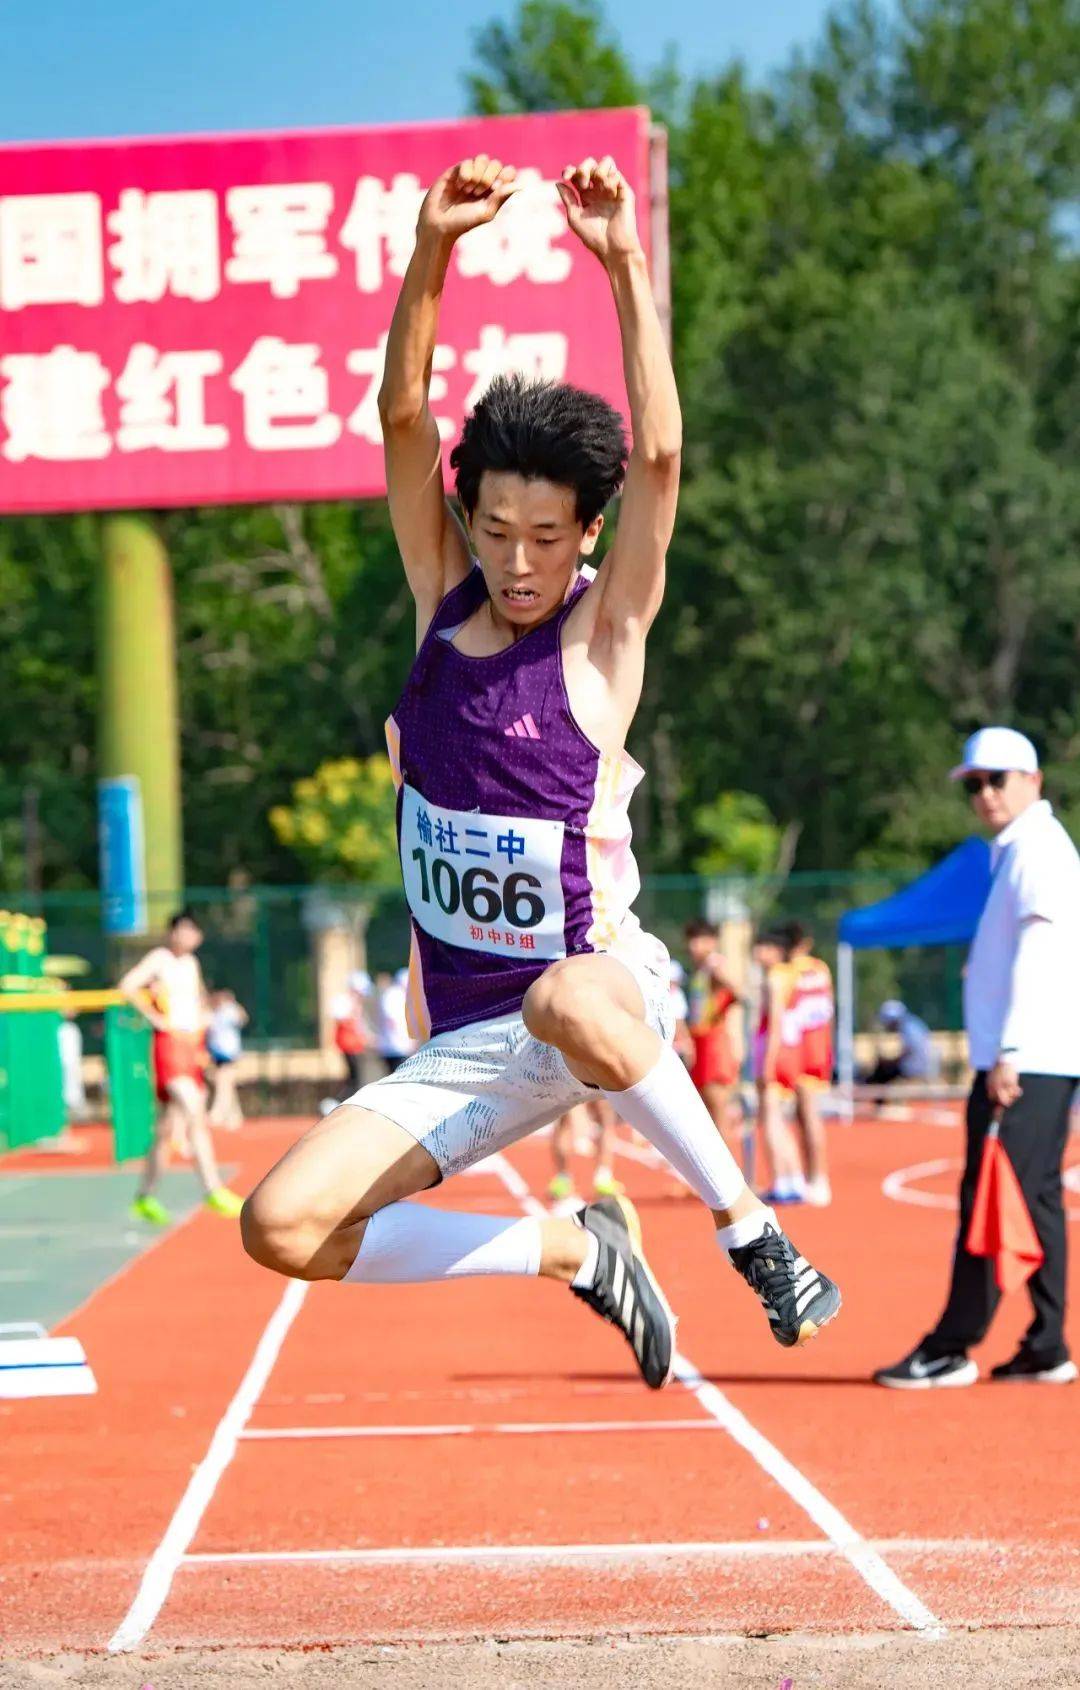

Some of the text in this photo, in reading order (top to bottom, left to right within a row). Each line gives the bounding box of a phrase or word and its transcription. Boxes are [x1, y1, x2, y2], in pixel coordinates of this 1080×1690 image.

[0, 168, 572, 311] 国拥军传统
[416, 806, 525, 864] 榆社二中
[412, 847, 545, 928] 1066
[470, 926, 536, 950] 初中B组
